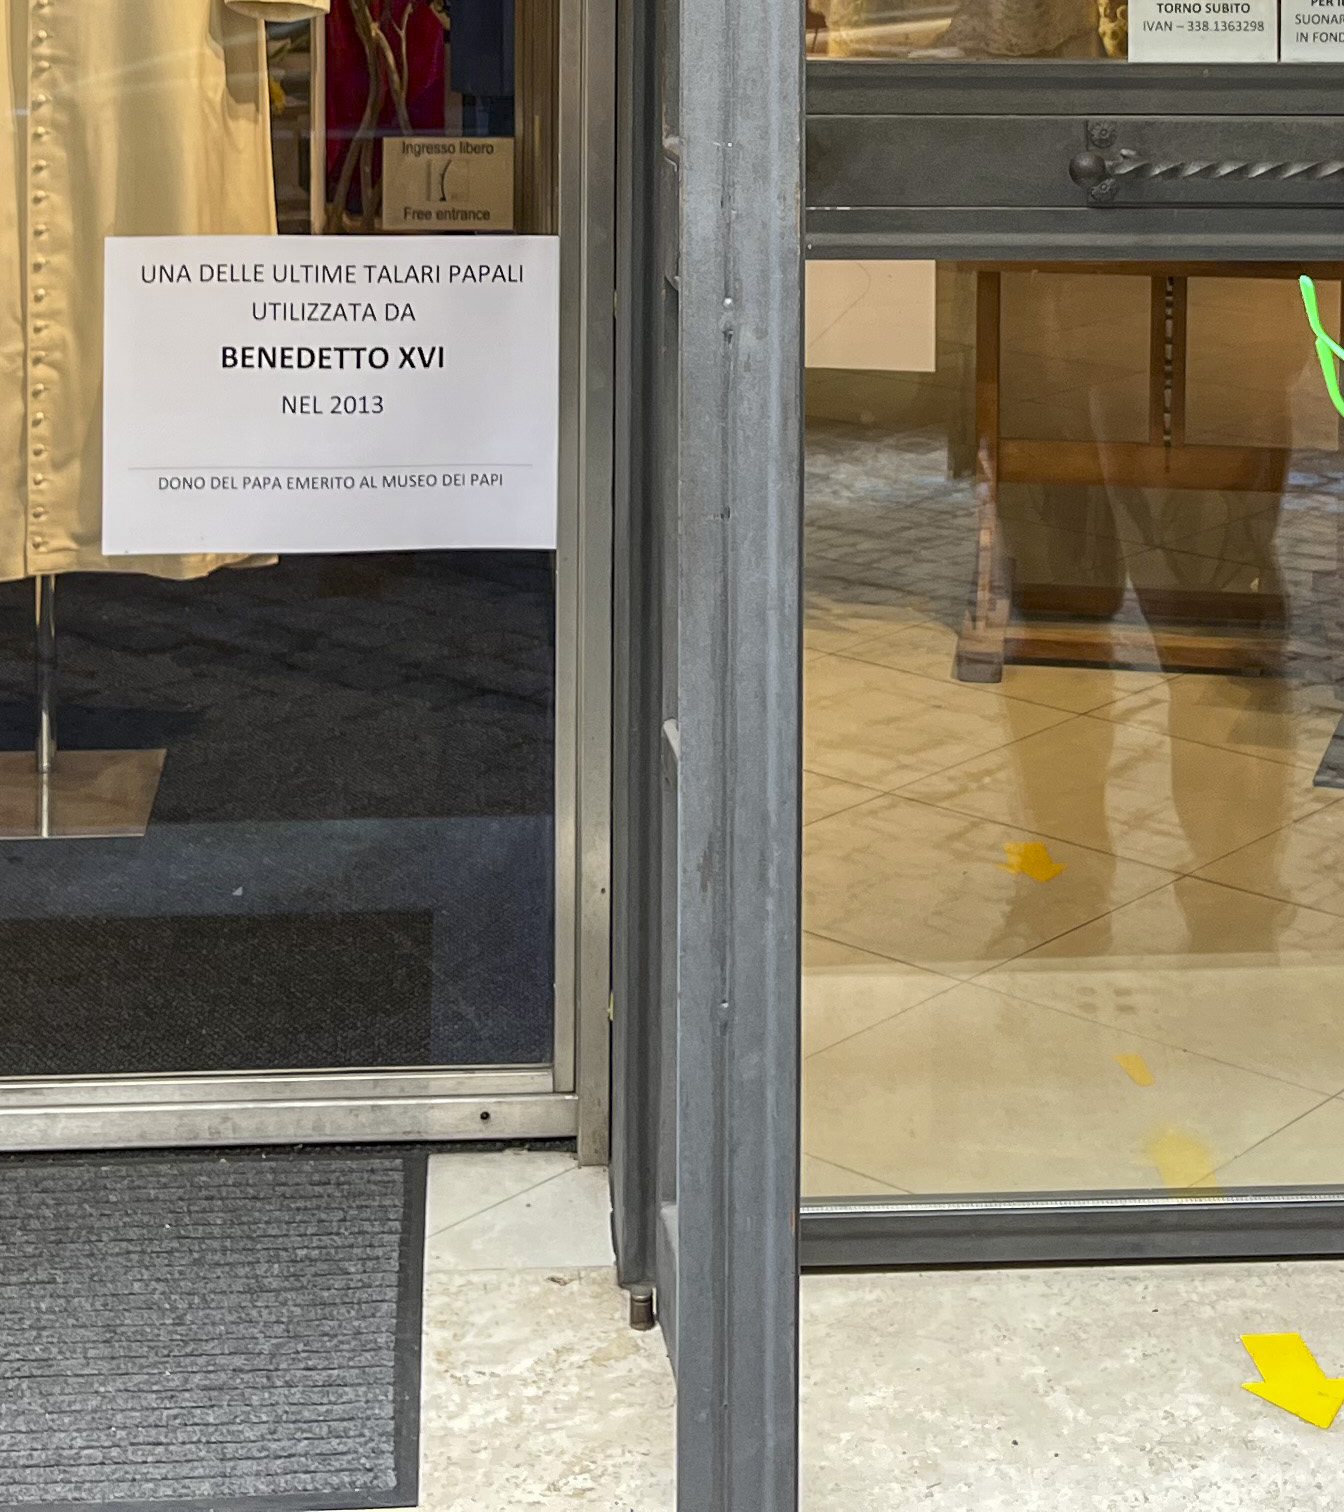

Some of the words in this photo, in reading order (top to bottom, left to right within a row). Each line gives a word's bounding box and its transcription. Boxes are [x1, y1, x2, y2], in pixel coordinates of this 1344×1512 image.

[1157, 2, 1202, 14] TORNO
[1205, 2, 1251, 14] SUBITO
[1143, 21, 1172, 32] IVAN
[1187, 20, 1265, 32] 338.1363298
[1295, 32, 1308, 43] IN
[402, 141, 456, 157] Ingresso
[459, 141, 494, 155] libero
[403, 206, 432, 221] Free
[436, 207, 490, 221] entrance
[141, 265, 191, 283] UNA
[199, 264, 265, 283] DELLE
[273, 264, 356, 283] ULTIME
[364, 264, 440, 283] TALARI
[449, 264, 523, 283] PAPALI
[252, 303, 375, 322] UTILIZZATA
[385, 303, 416, 321] DA
[221, 346, 389, 369] BENEDETTO
[398, 346, 444, 368] XVI
[282, 396, 323, 414] NEL
[330, 395, 384, 414] 2013
[159, 476, 205, 490] DONO
[211, 476, 238, 490] DEL
[243, 476, 282, 490] PAPA
[287, 475, 355, 490] EMERITO
[359, 475, 378, 489] AL
[382, 474, 437, 488] MUSEO
[442, 474, 465, 487] DEI
[471, 473, 503, 487] PAPI
